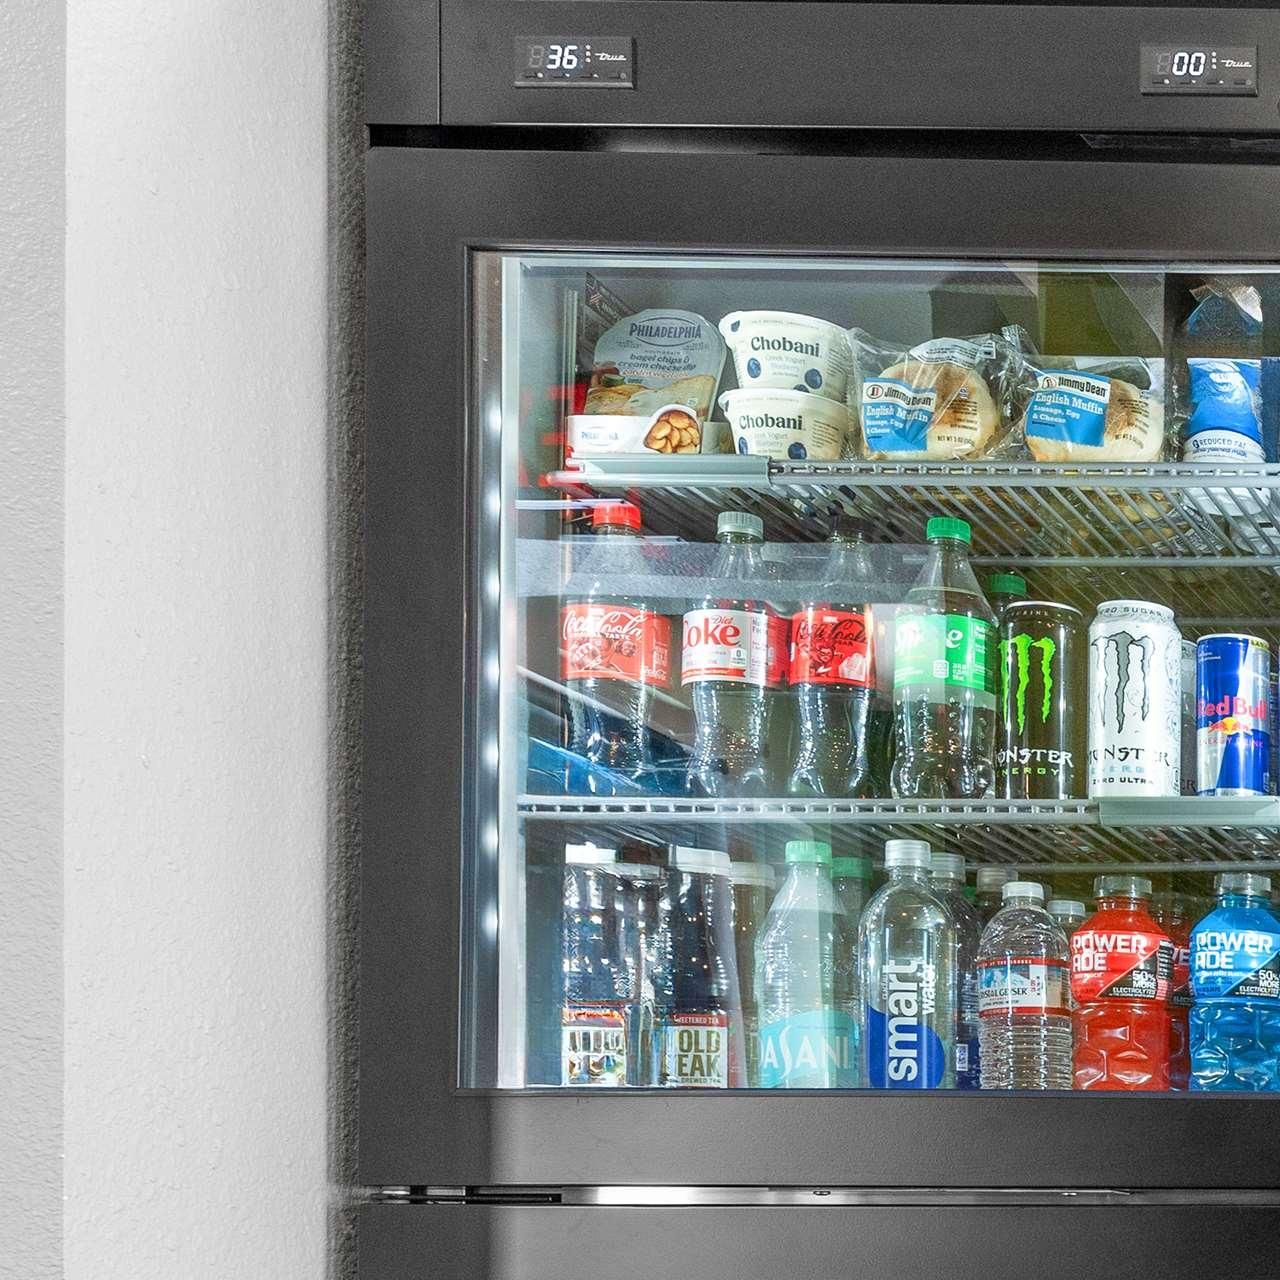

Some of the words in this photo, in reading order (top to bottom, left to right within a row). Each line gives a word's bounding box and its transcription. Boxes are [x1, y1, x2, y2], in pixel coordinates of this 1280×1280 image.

[546, 45, 577, 69] 36
[1172, 52, 1206, 76] 00
[750, 335, 820, 357] Chobani
[1084, 382, 1107, 398] Dean
[1034, 392, 1070, 405] English
[1071, 398, 1104, 414] Muffin
[738, 414, 804, 430] Chobani
[1072, 934, 1149, 953] POWER
[1196, 932, 1272, 953] POWER
[1072, 952, 1107, 972] ADE
[1195, 951, 1234, 970] ADE
[884, 960, 921, 1082] smart
[758, 1024, 849, 1083] ASANI
